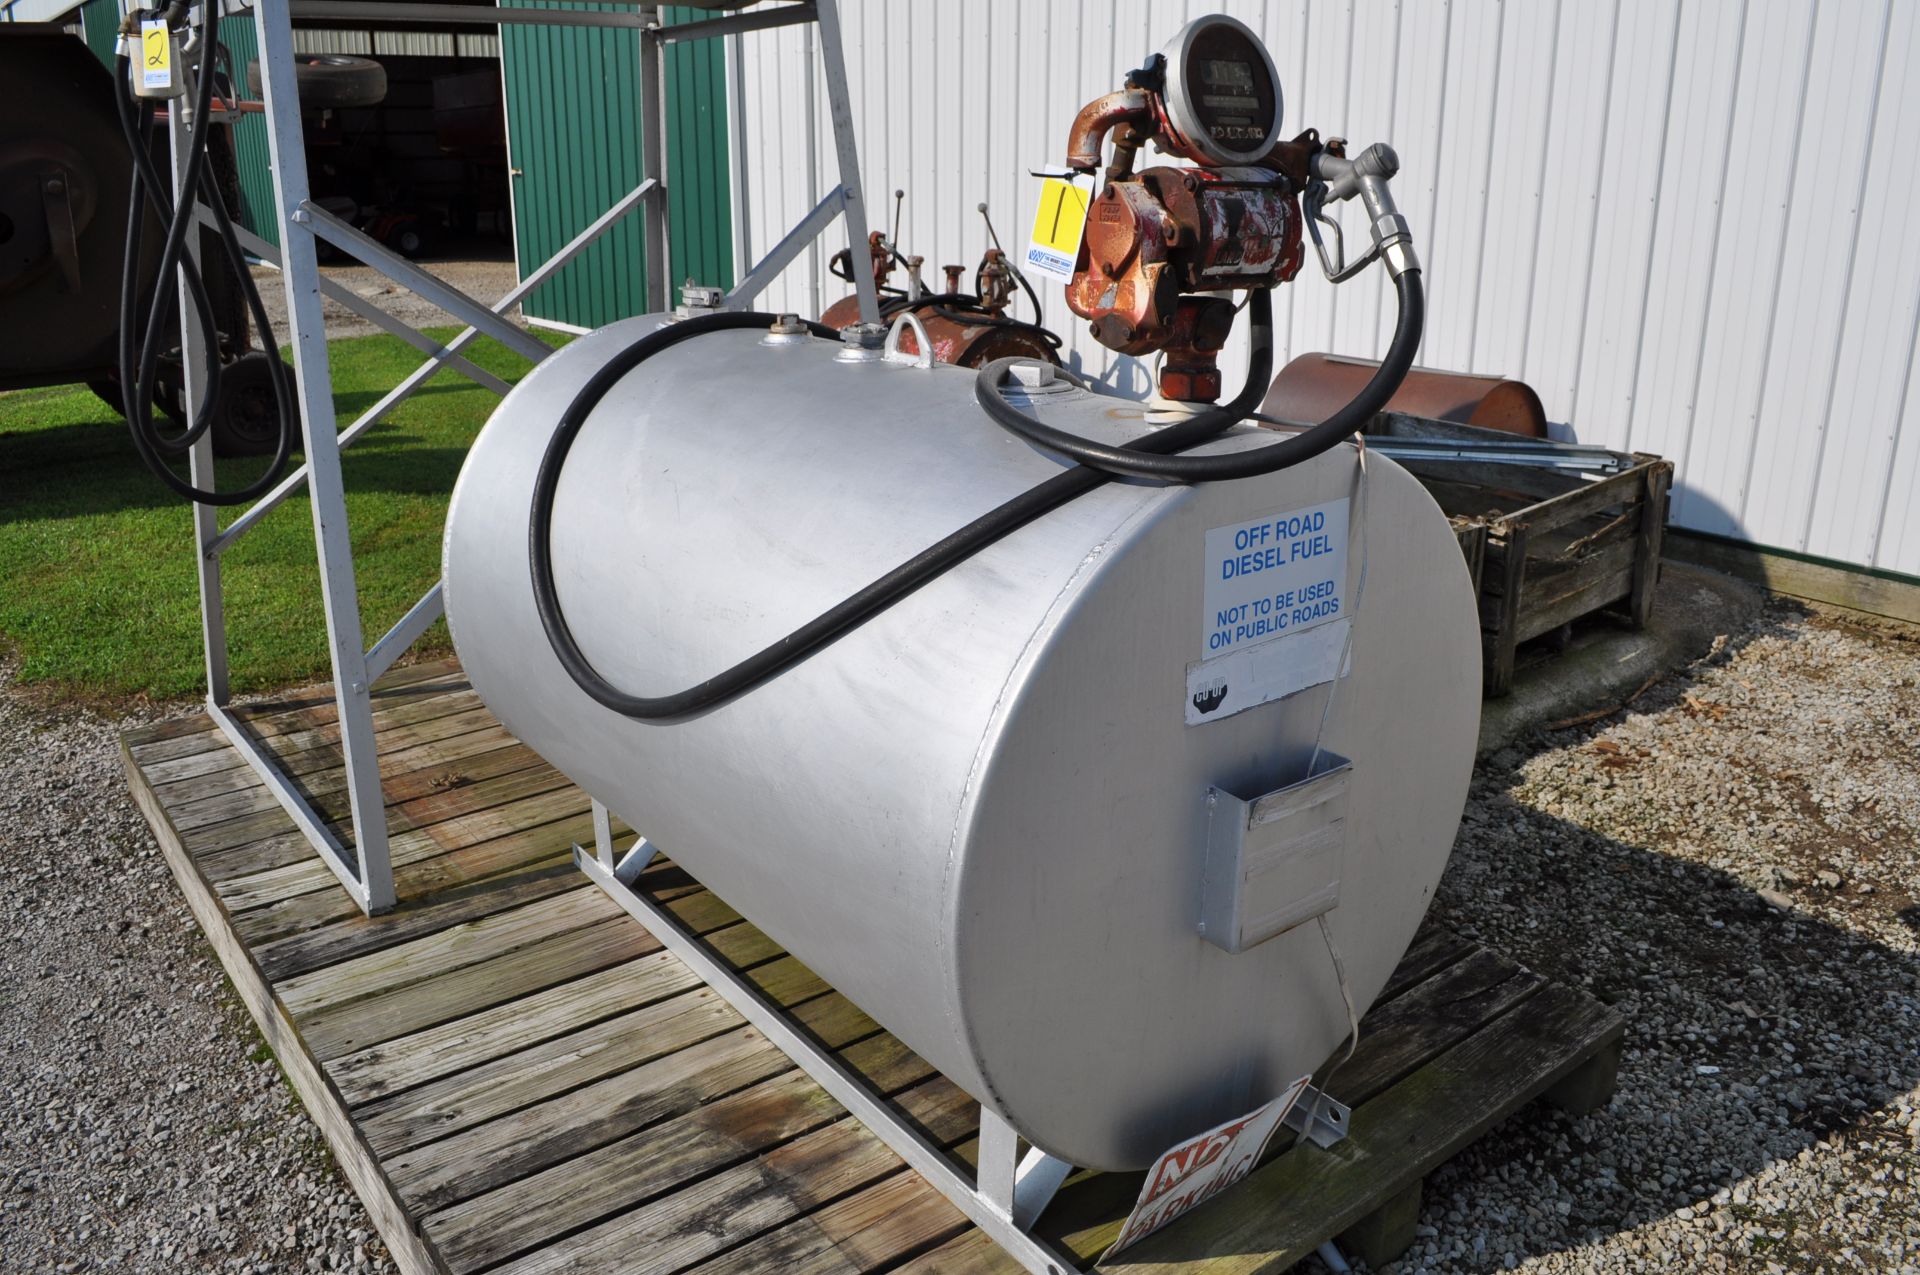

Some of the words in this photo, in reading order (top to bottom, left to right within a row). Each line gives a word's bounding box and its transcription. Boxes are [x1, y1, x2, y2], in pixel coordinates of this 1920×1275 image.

[148, 30, 164, 66] 2
[1050, 186, 1067, 244] 1
[1235, 523, 1271, 550] OFF
[1276, 511, 1325, 541] ROAD
[1222, 547, 1286, 580] DIESEL
[1291, 534, 1333, 562] FUEL
[1209, 629, 1231, 650] ON
[1236, 613, 1288, 642] PUBLIC
[1292, 597, 1339, 625] ROADS
[1217, 604, 1249, 627] NOT
[1252, 598, 1271, 617] TO
[1276, 591, 1294, 611] BE
[1298, 580, 1335, 604] USED
[1154, 1133, 1231, 1197] NO
